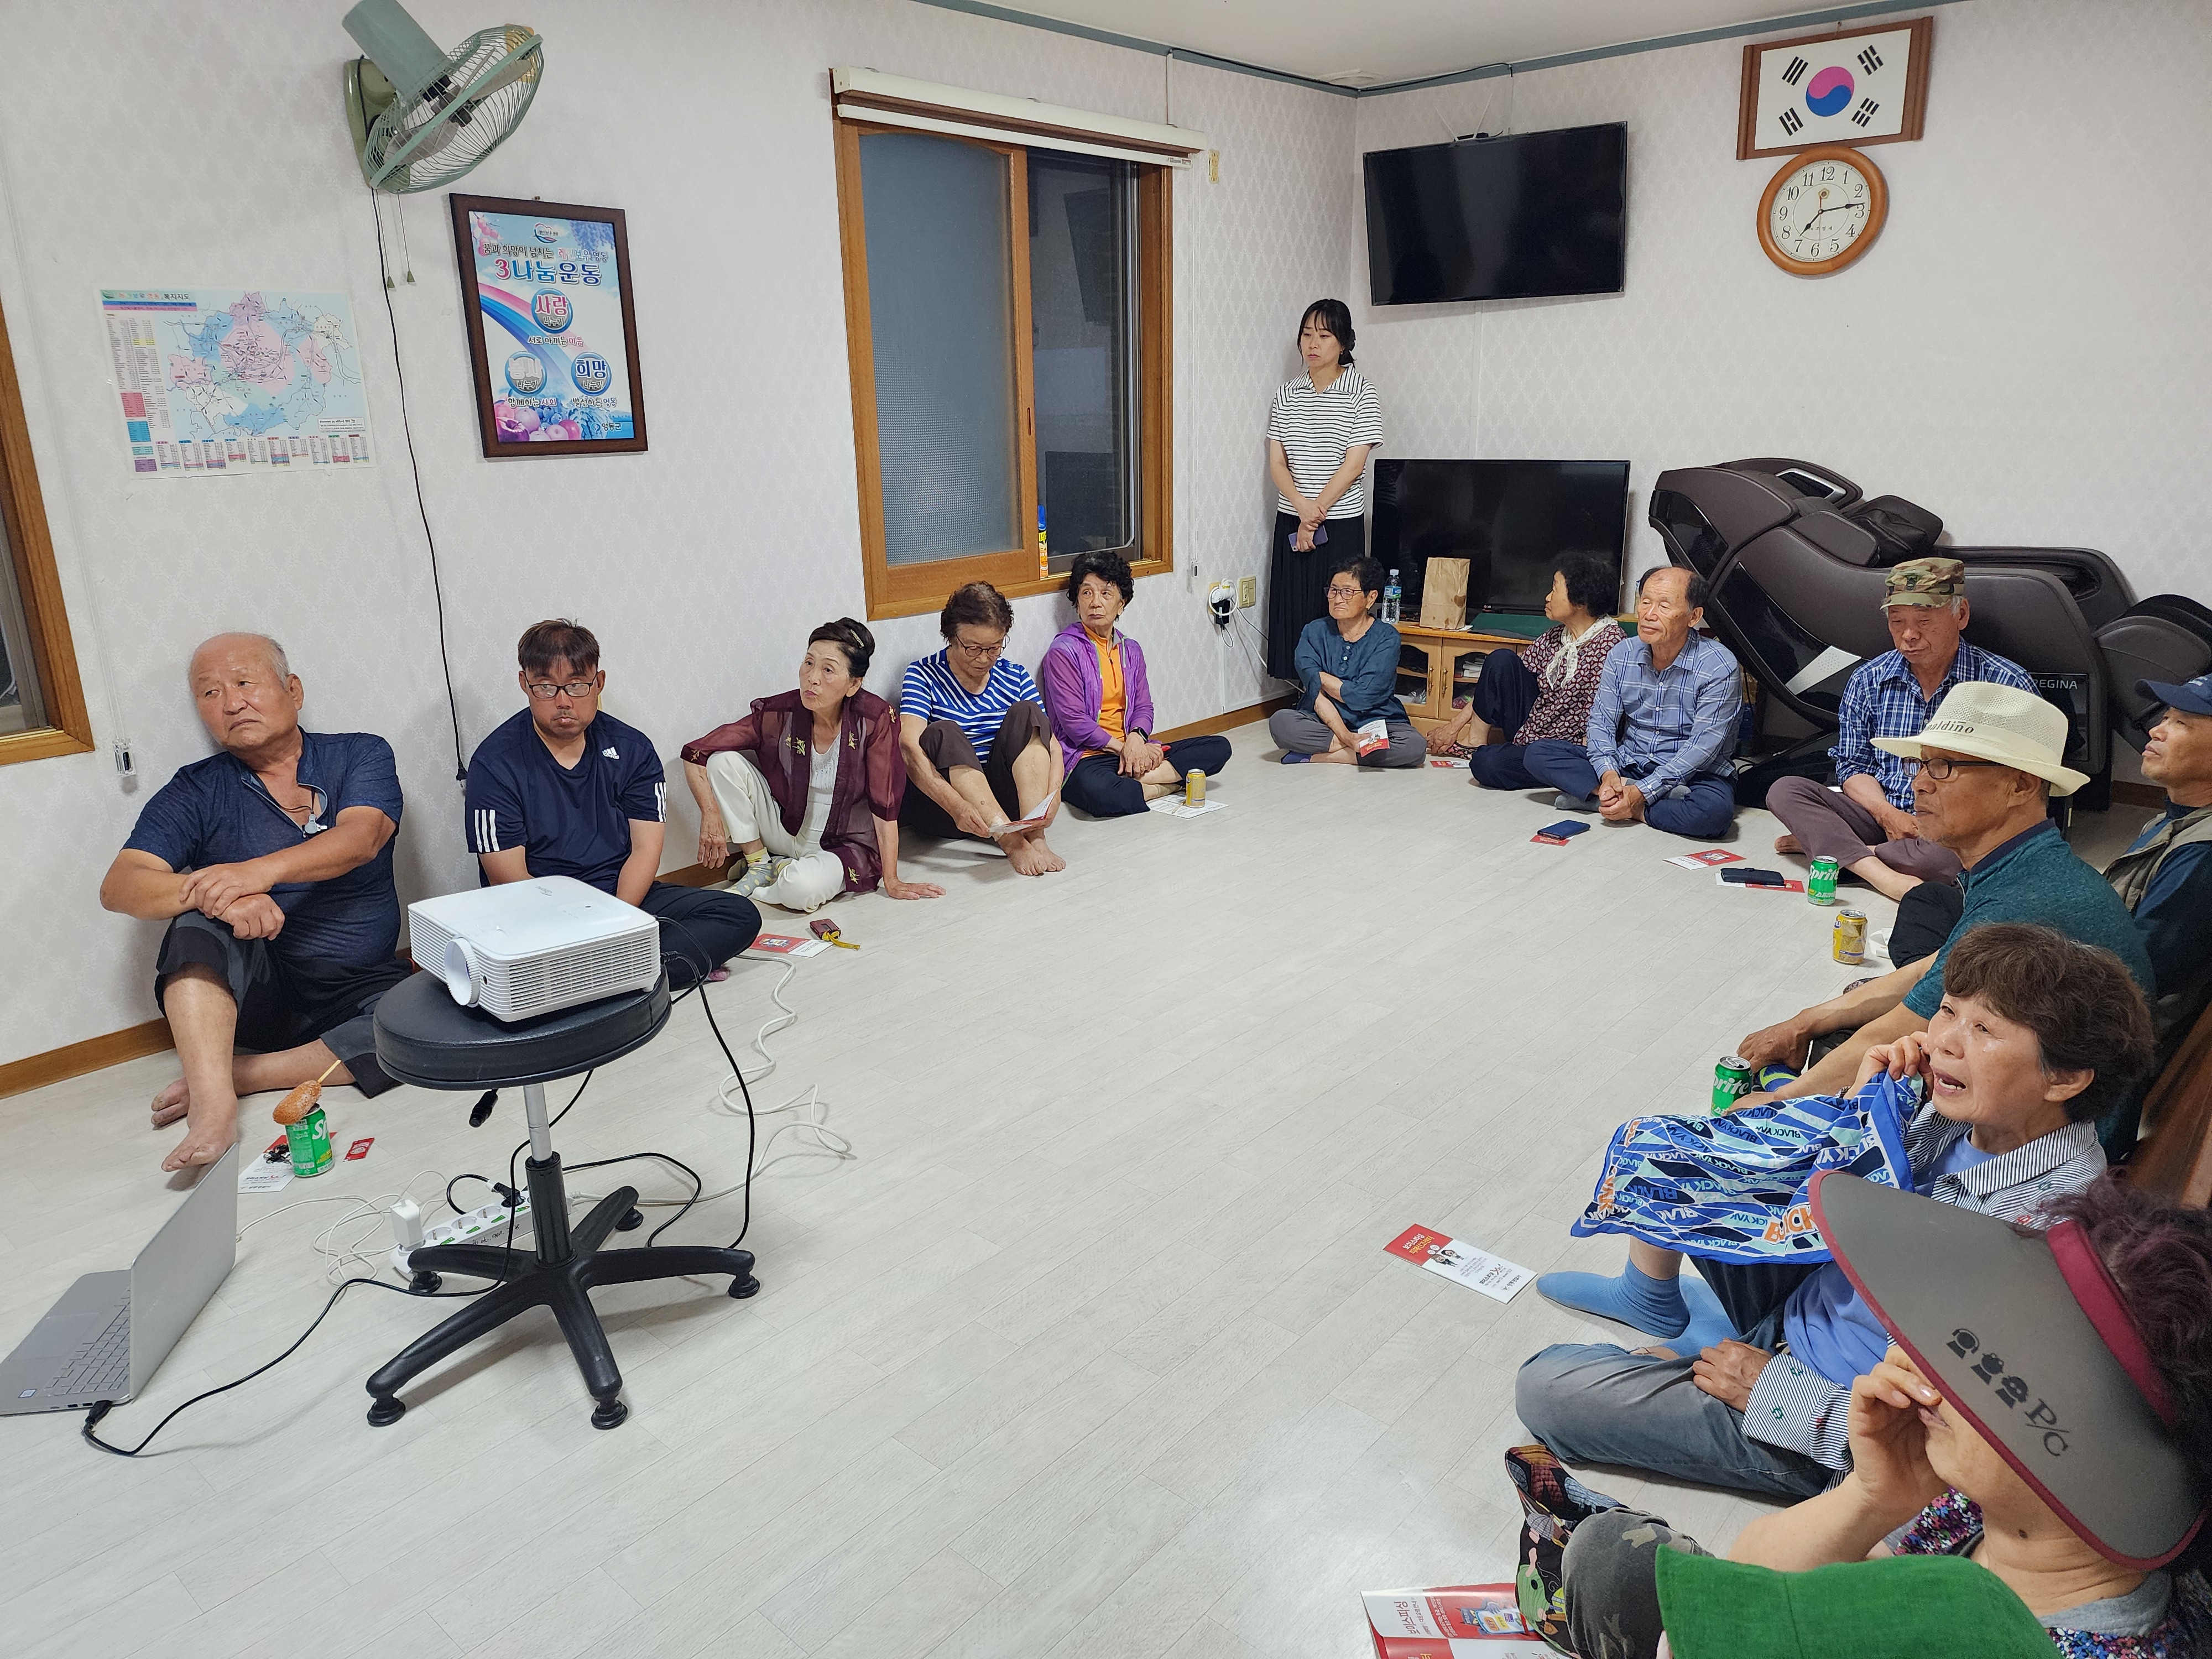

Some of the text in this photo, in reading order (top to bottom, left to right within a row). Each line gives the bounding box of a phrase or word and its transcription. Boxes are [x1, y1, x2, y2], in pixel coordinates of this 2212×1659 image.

[1802, 172, 1814, 186] 11
[1820, 166, 1835, 181] 12
[1843, 170, 1848, 185] 1
[1786, 186, 1799, 201] 10
[1854, 184, 1863, 198] 2
[1779, 206, 1788, 221] 9
[1855, 202, 1865, 218] 3
[1781, 225, 1791, 239] 8
[1845, 223, 1856, 238] 4
[483, 243, 608, 263] 꿈과 희망이 넘치는 레인보우 영동
[1794, 239, 1803, 253] 7
[1811, 242, 1820, 257] 6
[1830, 238, 1839, 253] 5
[494, 258, 602, 286] 3나눔운동
[536, 295, 568, 316] 사랑
[543, 316, 565, 327] 나누기
[528, 336, 584, 347] 서로 아끼는 마음
[508, 357, 543, 379] 봉사
[575, 359, 607, 379] 희망
[517, 380, 540, 390] 나누기
[583, 380, 604, 390] 나누기
[508, 398, 558, 409] 함께하는 사회
[572, 397, 617, 408] 발전하는 영동
[602, 423, 622, 432] 영동군
[1402, 1233, 1425, 1250] 보이스피싱
[1394, 1601, 1421, 1635] 보이스피싱
